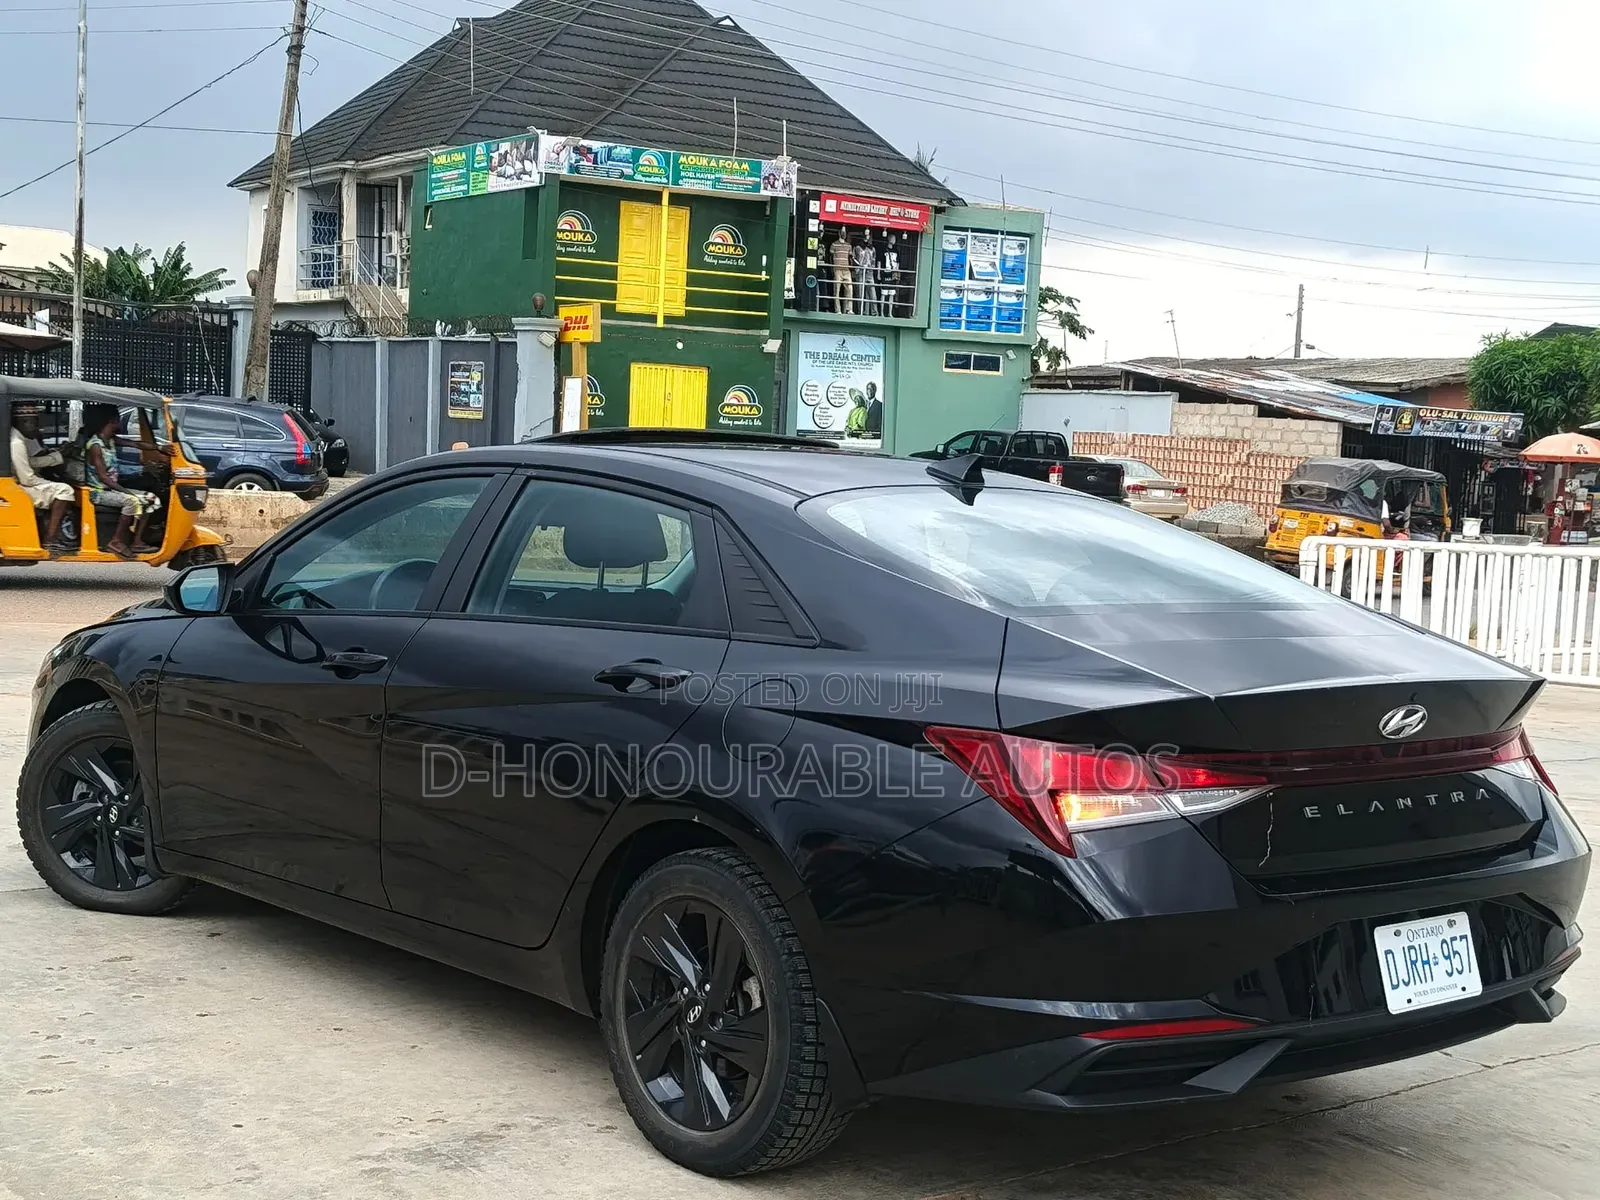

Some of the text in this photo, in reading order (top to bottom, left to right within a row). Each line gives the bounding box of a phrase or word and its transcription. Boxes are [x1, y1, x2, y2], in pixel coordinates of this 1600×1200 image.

[637, 165, 666, 175] MOUKA
[678, 155, 717, 167] MOUKA
[719, 160, 750, 171] FOAM
[556, 231, 593, 242] MOUKA
[707, 244, 743, 255] MOUKA
[803, 350, 881, 363] THE DREAM CENTRE
[722, 405, 759, 415] MOUKA
[1419, 408, 1511, 423] OLU-SAL FURNITURE
[1302, 788, 1490, 818] ELANTRA
[1406, 924, 1444, 942] ONTARIO
[1384, 934, 1472, 991] DJRH 957
[1413, 983, 1458, 998] YOURS TO DISCOVER
